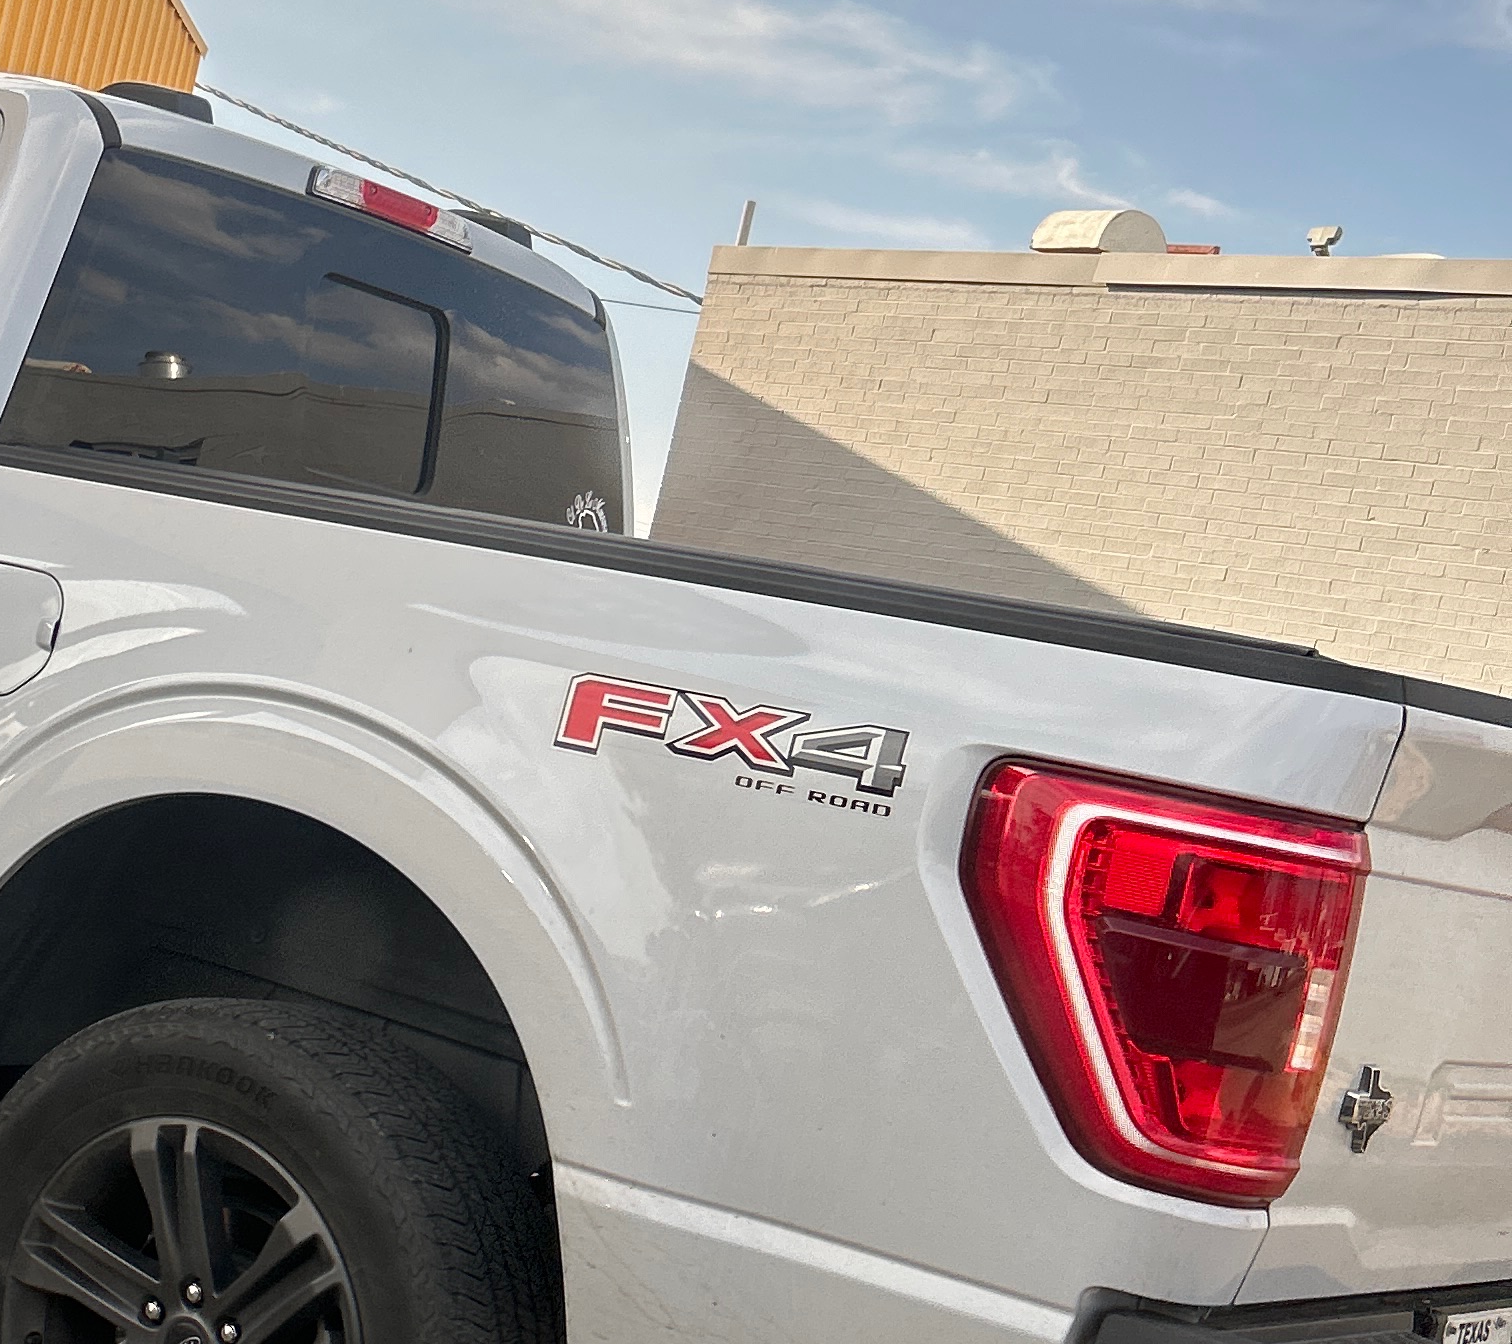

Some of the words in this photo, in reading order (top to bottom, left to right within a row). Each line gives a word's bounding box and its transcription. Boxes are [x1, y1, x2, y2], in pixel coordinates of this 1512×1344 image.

[553, 671, 910, 798] FX4
[734, 775, 796, 796] OFF
[806, 789, 892, 819] ROAD
